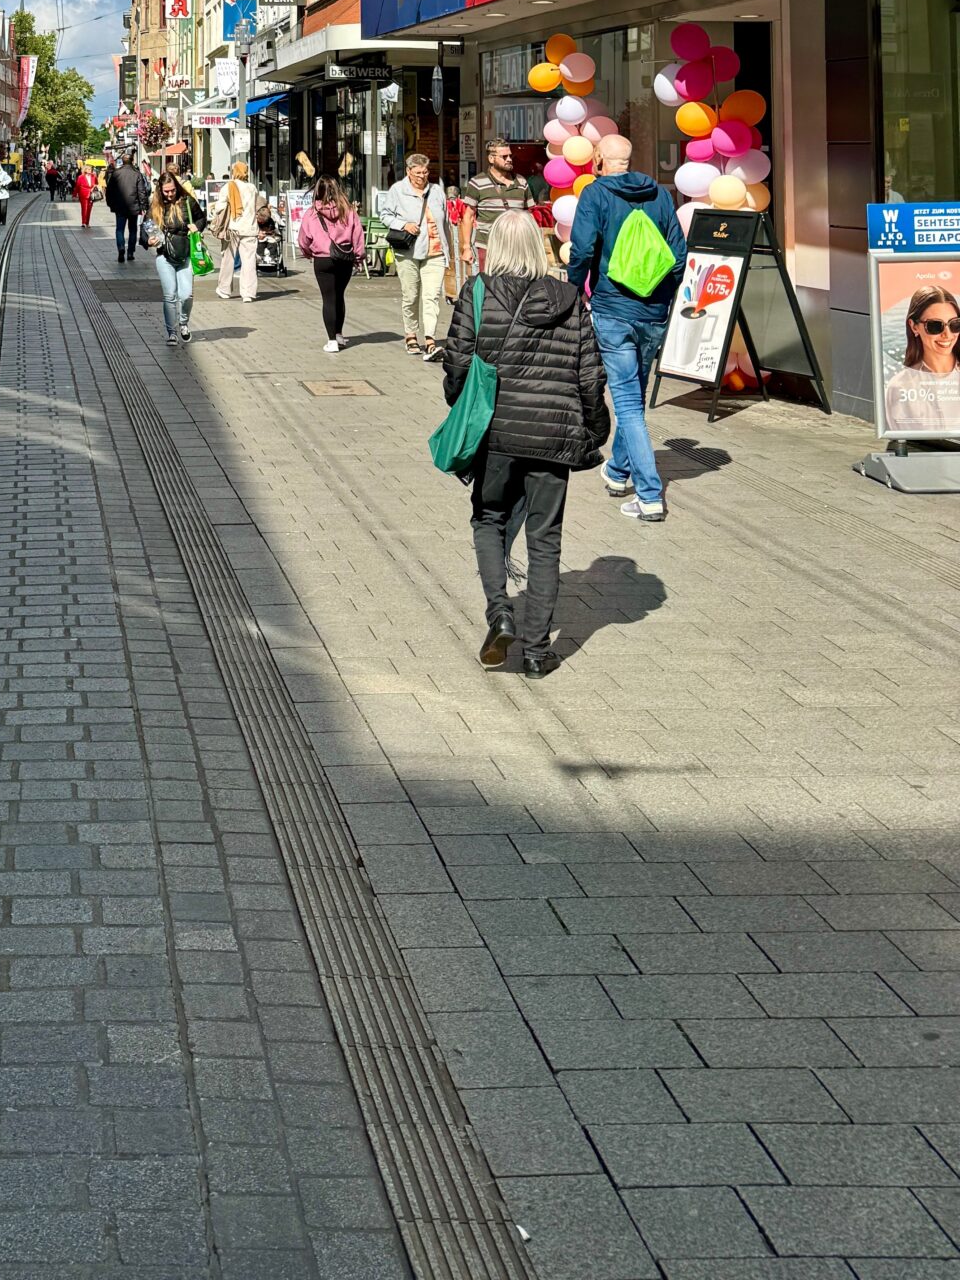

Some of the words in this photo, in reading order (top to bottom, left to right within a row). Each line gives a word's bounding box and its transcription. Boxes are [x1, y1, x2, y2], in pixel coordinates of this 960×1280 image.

[199, 116, 227, 126] CURRY
[917, 218, 960, 227] SEHTEST
[917, 233, 936, 242] BEI
[898, 388, 918, 402] 30
